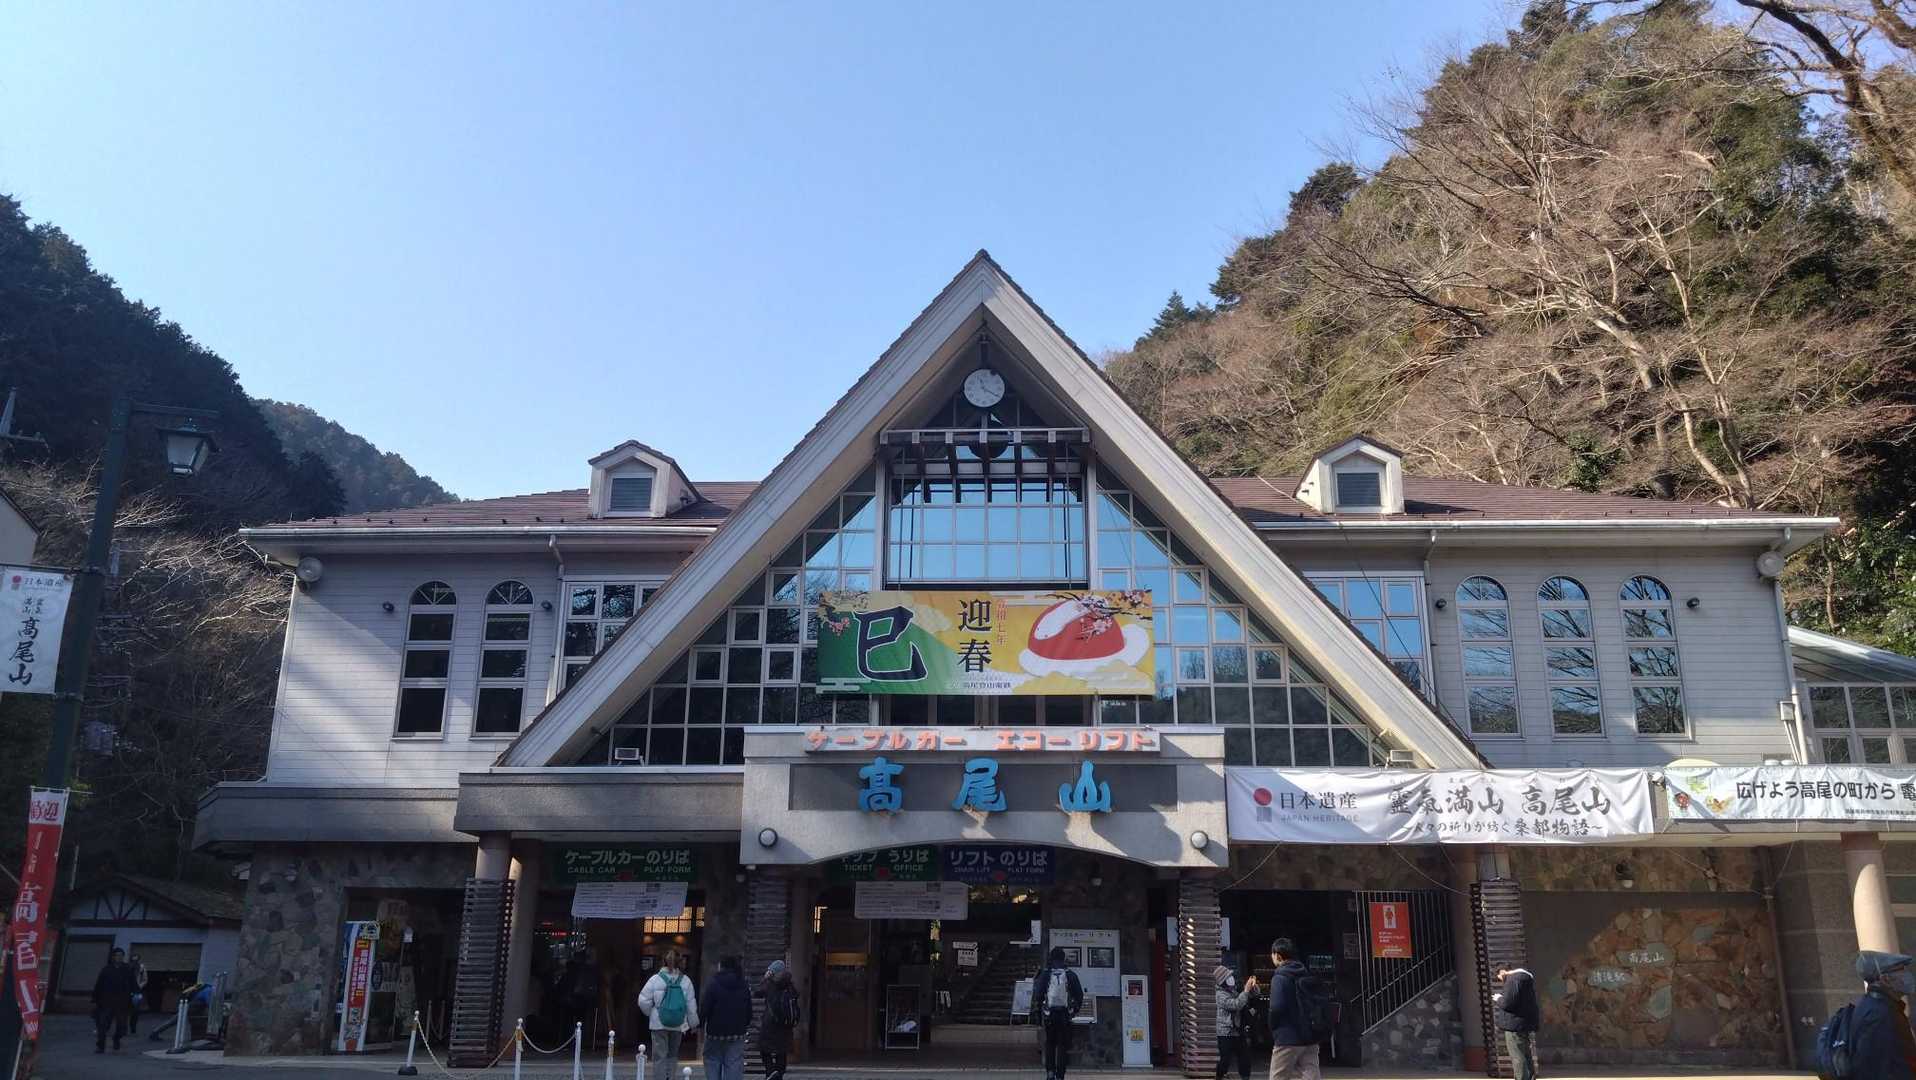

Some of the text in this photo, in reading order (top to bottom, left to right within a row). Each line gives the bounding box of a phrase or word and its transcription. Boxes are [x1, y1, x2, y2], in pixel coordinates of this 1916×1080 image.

[853, 605, 929, 682] 巳
[957, 598, 992, 673] 迎春
[8, 617, 40, 686] 高尾山
[806, 730, 1153, 750] ケーブルカー エコーリフト
[858, 757, 1111, 813] 高尾山
[1736, 781, 1896, 800] 広げよう高尾の町から
[1280, 791, 1358, 810] 日本遺産
[1521, 784, 1611, 816] 高尾山
[1281, 814, 1360, 823] JAPAN HERITAGE
[564, 849, 690, 865] ケーブルカーのりば
[951, 851, 1049, 866] リフト のりば
[567, 866, 594, 874] CABLE
[598, 866, 616, 874] CAR
[845, 864, 924, 872] TICKET OFFICE
